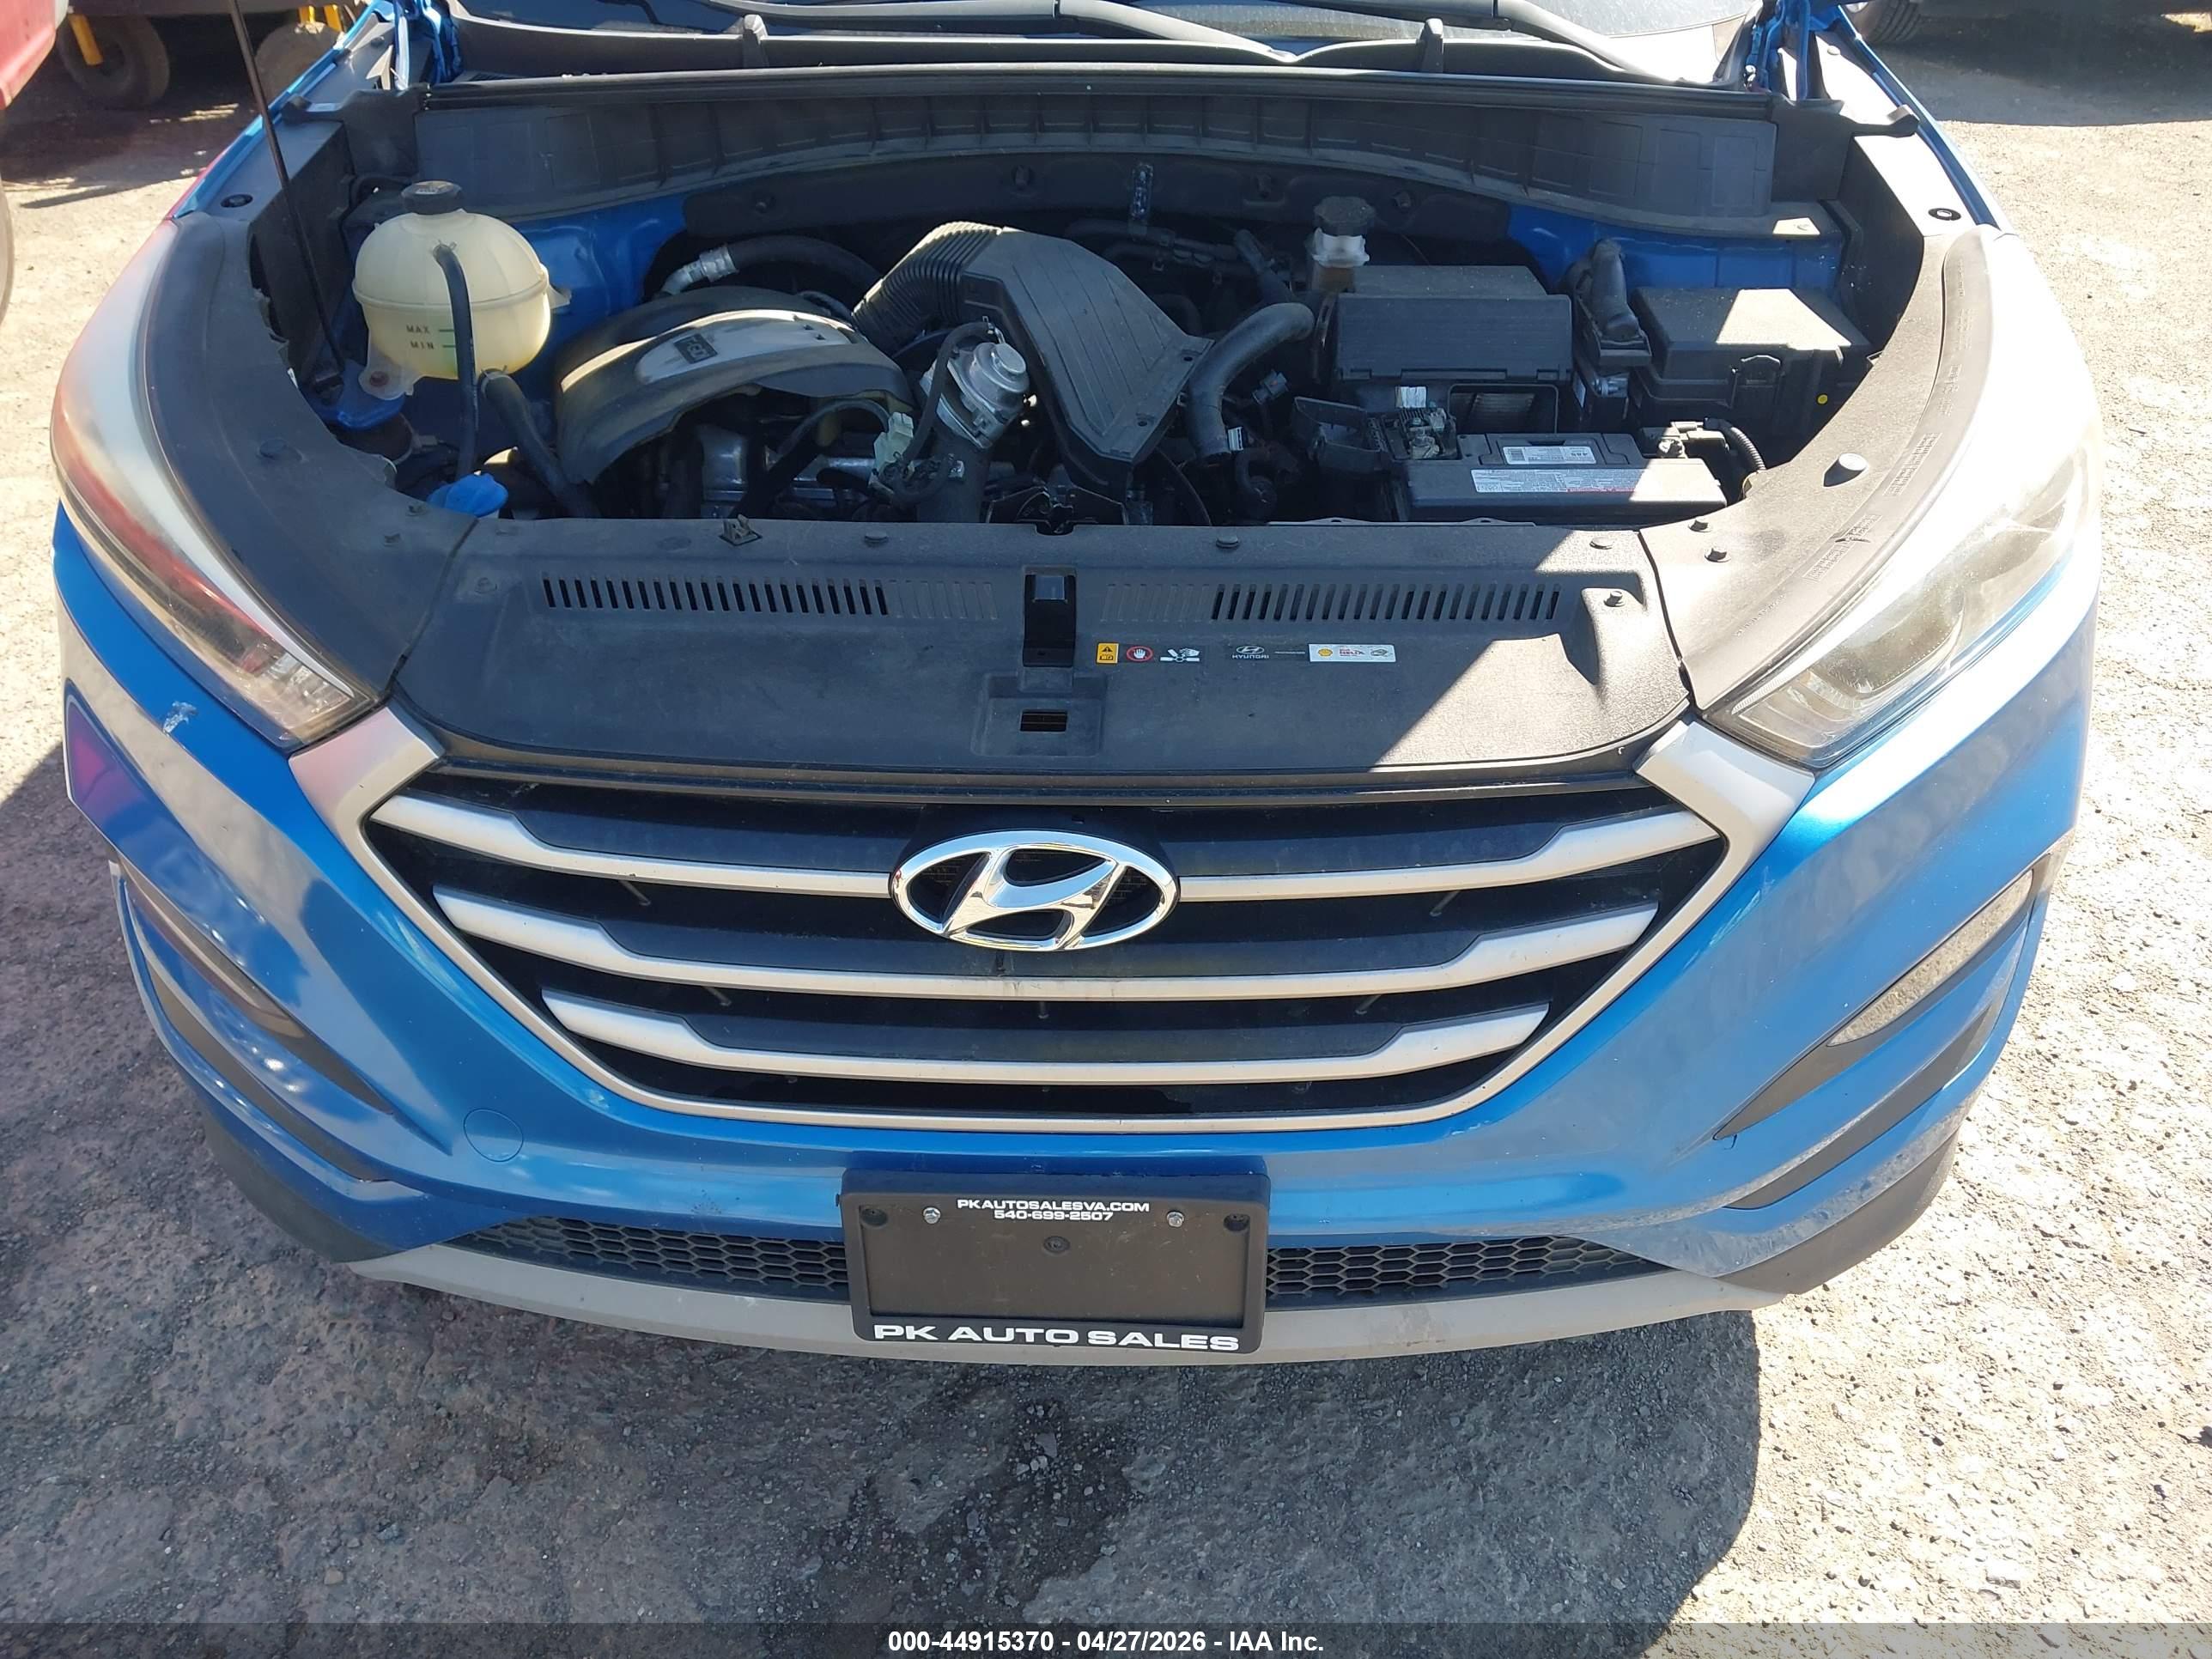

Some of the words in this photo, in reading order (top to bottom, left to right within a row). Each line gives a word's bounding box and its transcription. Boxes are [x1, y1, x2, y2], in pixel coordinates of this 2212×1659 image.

[405, 325, 431, 334] MAX
[410, 341, 434, 350] MIN
[957, 1199, 1150, 1212] PKAUTOSALESVA.COM
[994, 1209, 1114, 1221] 540-699-2507
[873, 1324, 939, 1340] PK
[948, 1326, 1080, 1345] AUTO
[1087, 1332, 1239, 1352] SALES
